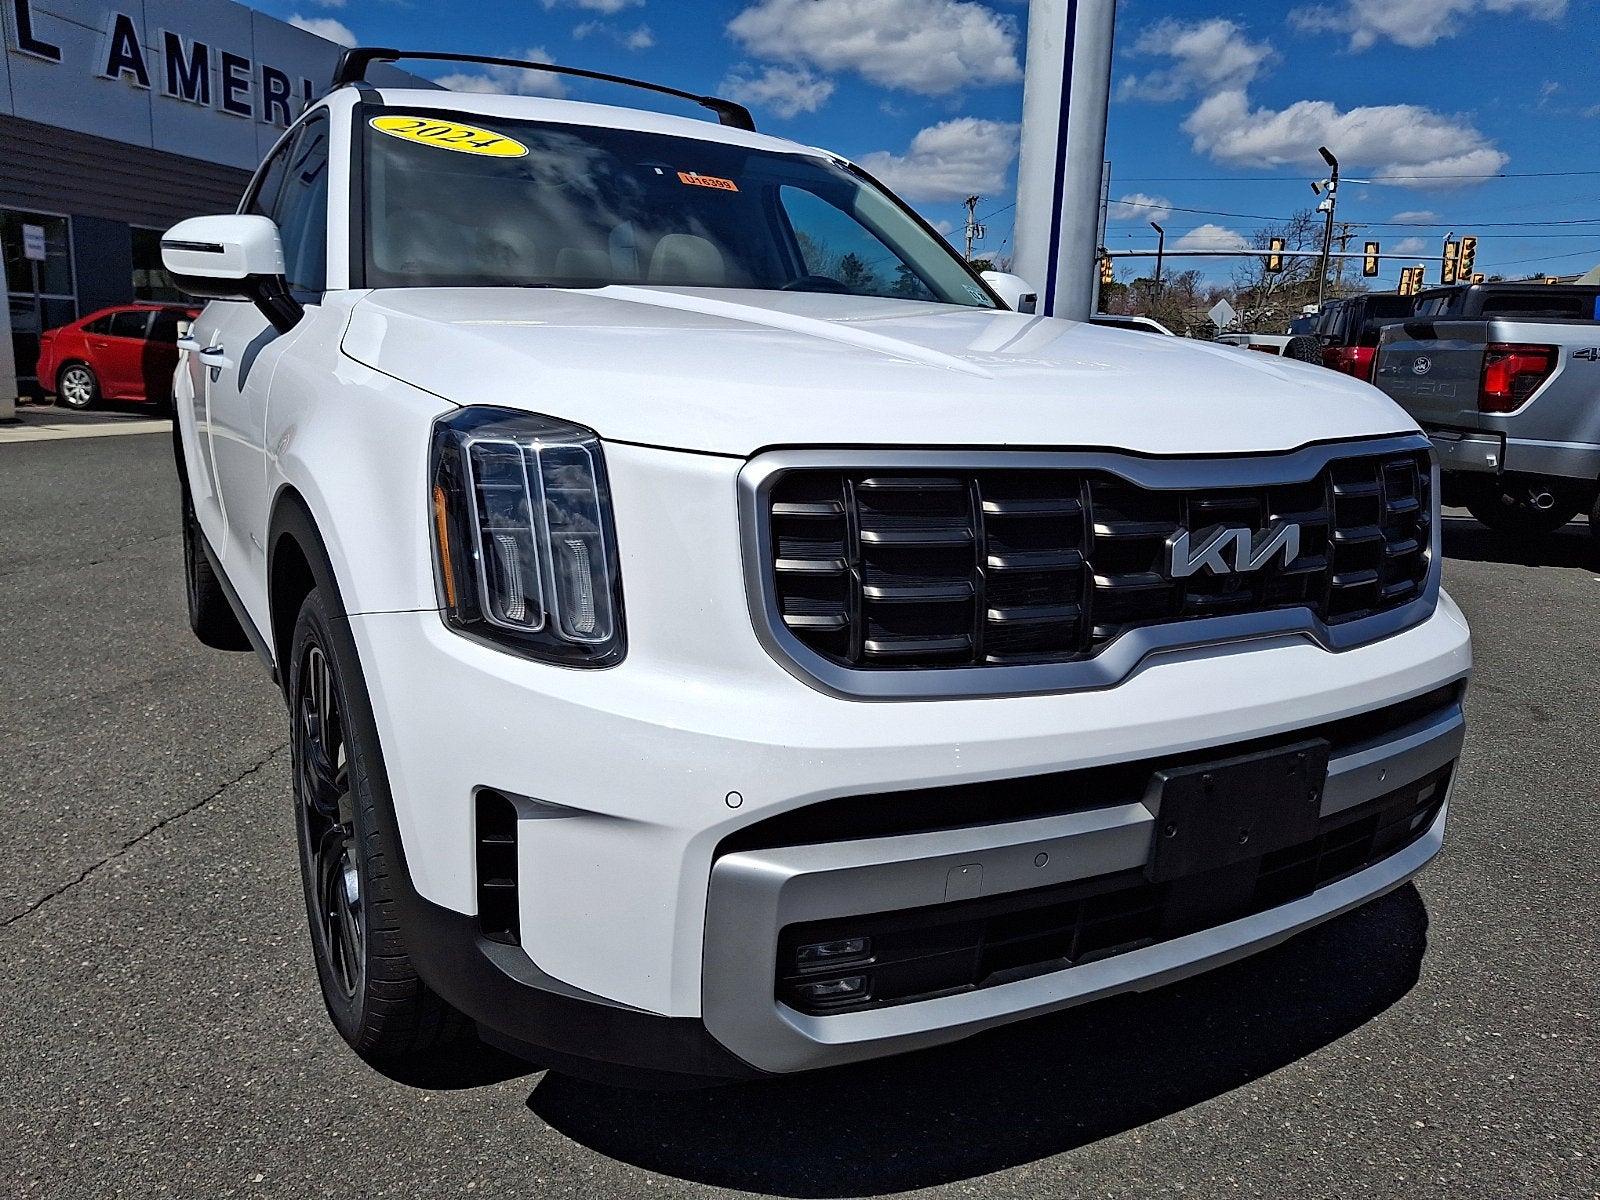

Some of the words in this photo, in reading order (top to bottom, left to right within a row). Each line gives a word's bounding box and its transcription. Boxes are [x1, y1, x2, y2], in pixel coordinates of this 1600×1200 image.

[386, 120, 505, 148] 2024
[684, 175, 732, 189] U16399
[1170, 523, 1300, 578] KIA
